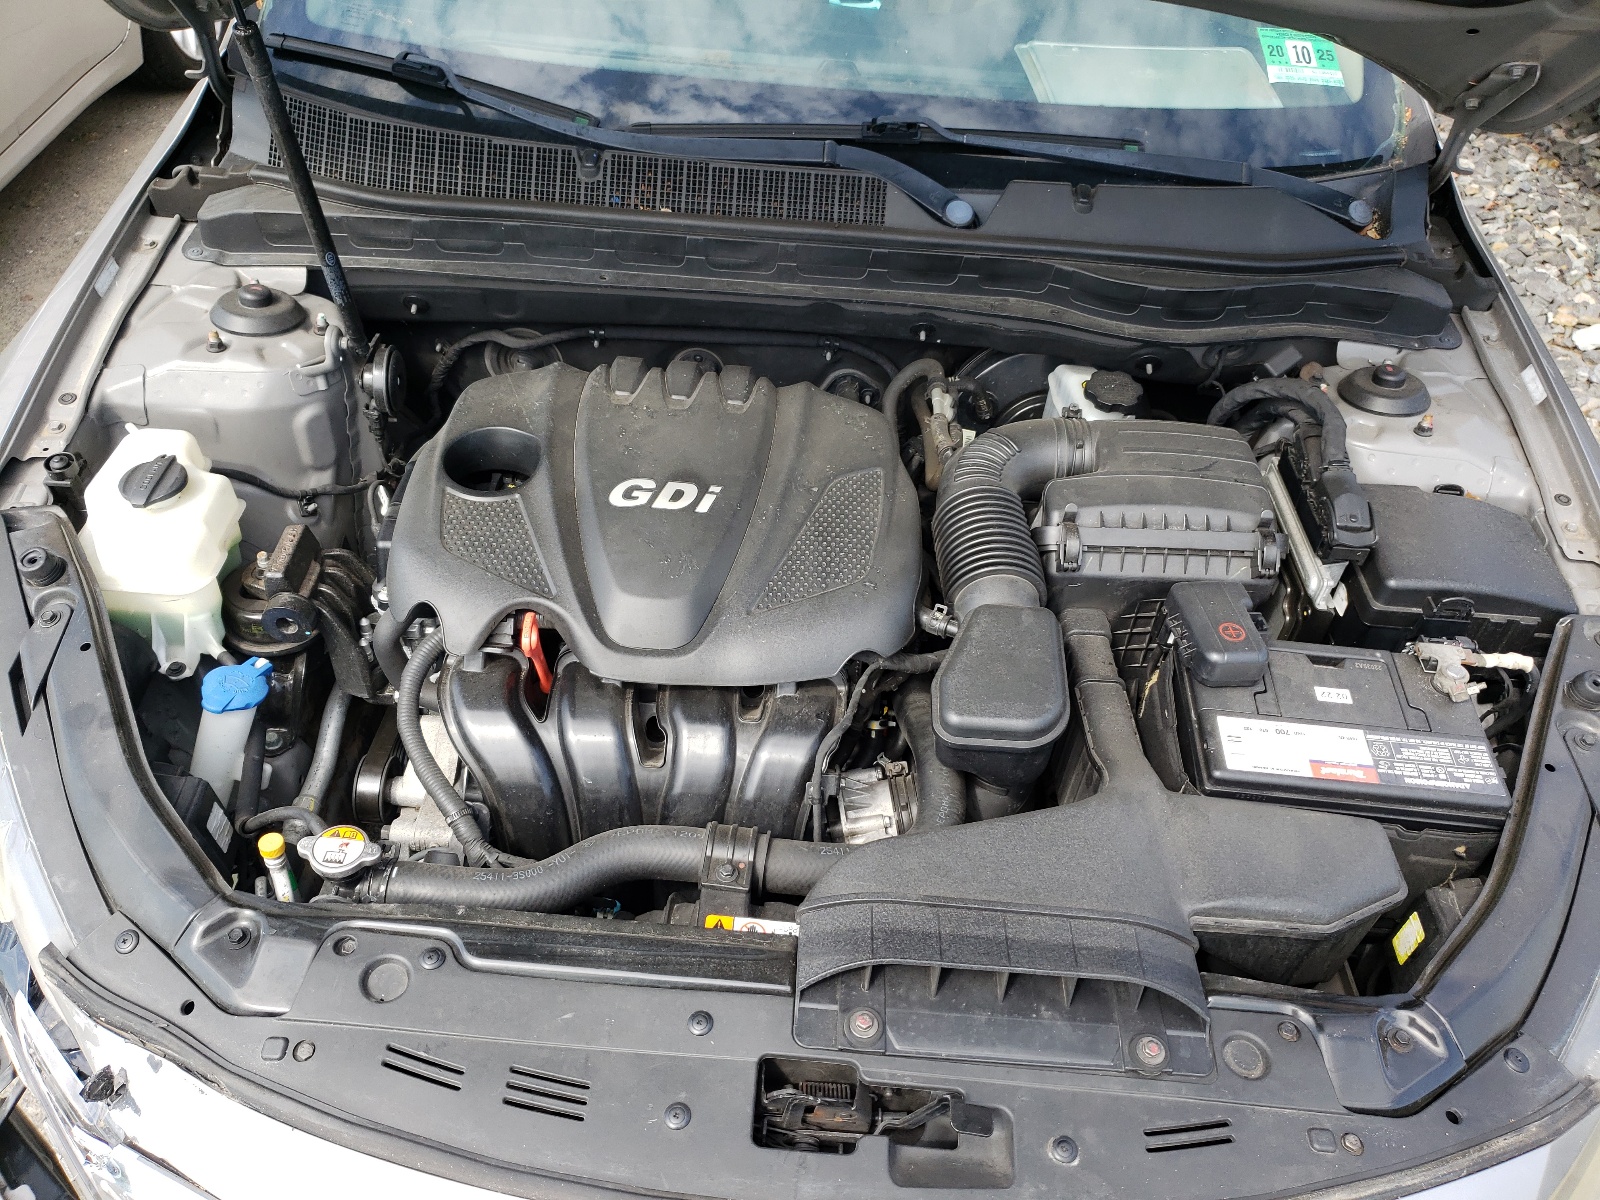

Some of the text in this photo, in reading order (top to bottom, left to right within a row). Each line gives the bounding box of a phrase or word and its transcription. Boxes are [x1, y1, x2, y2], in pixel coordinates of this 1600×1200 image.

[1267, 44, 1335, 65] 20 10 25
[608, 478, 724, 513] GDi
[1275, 728, 1290, 736] 700
